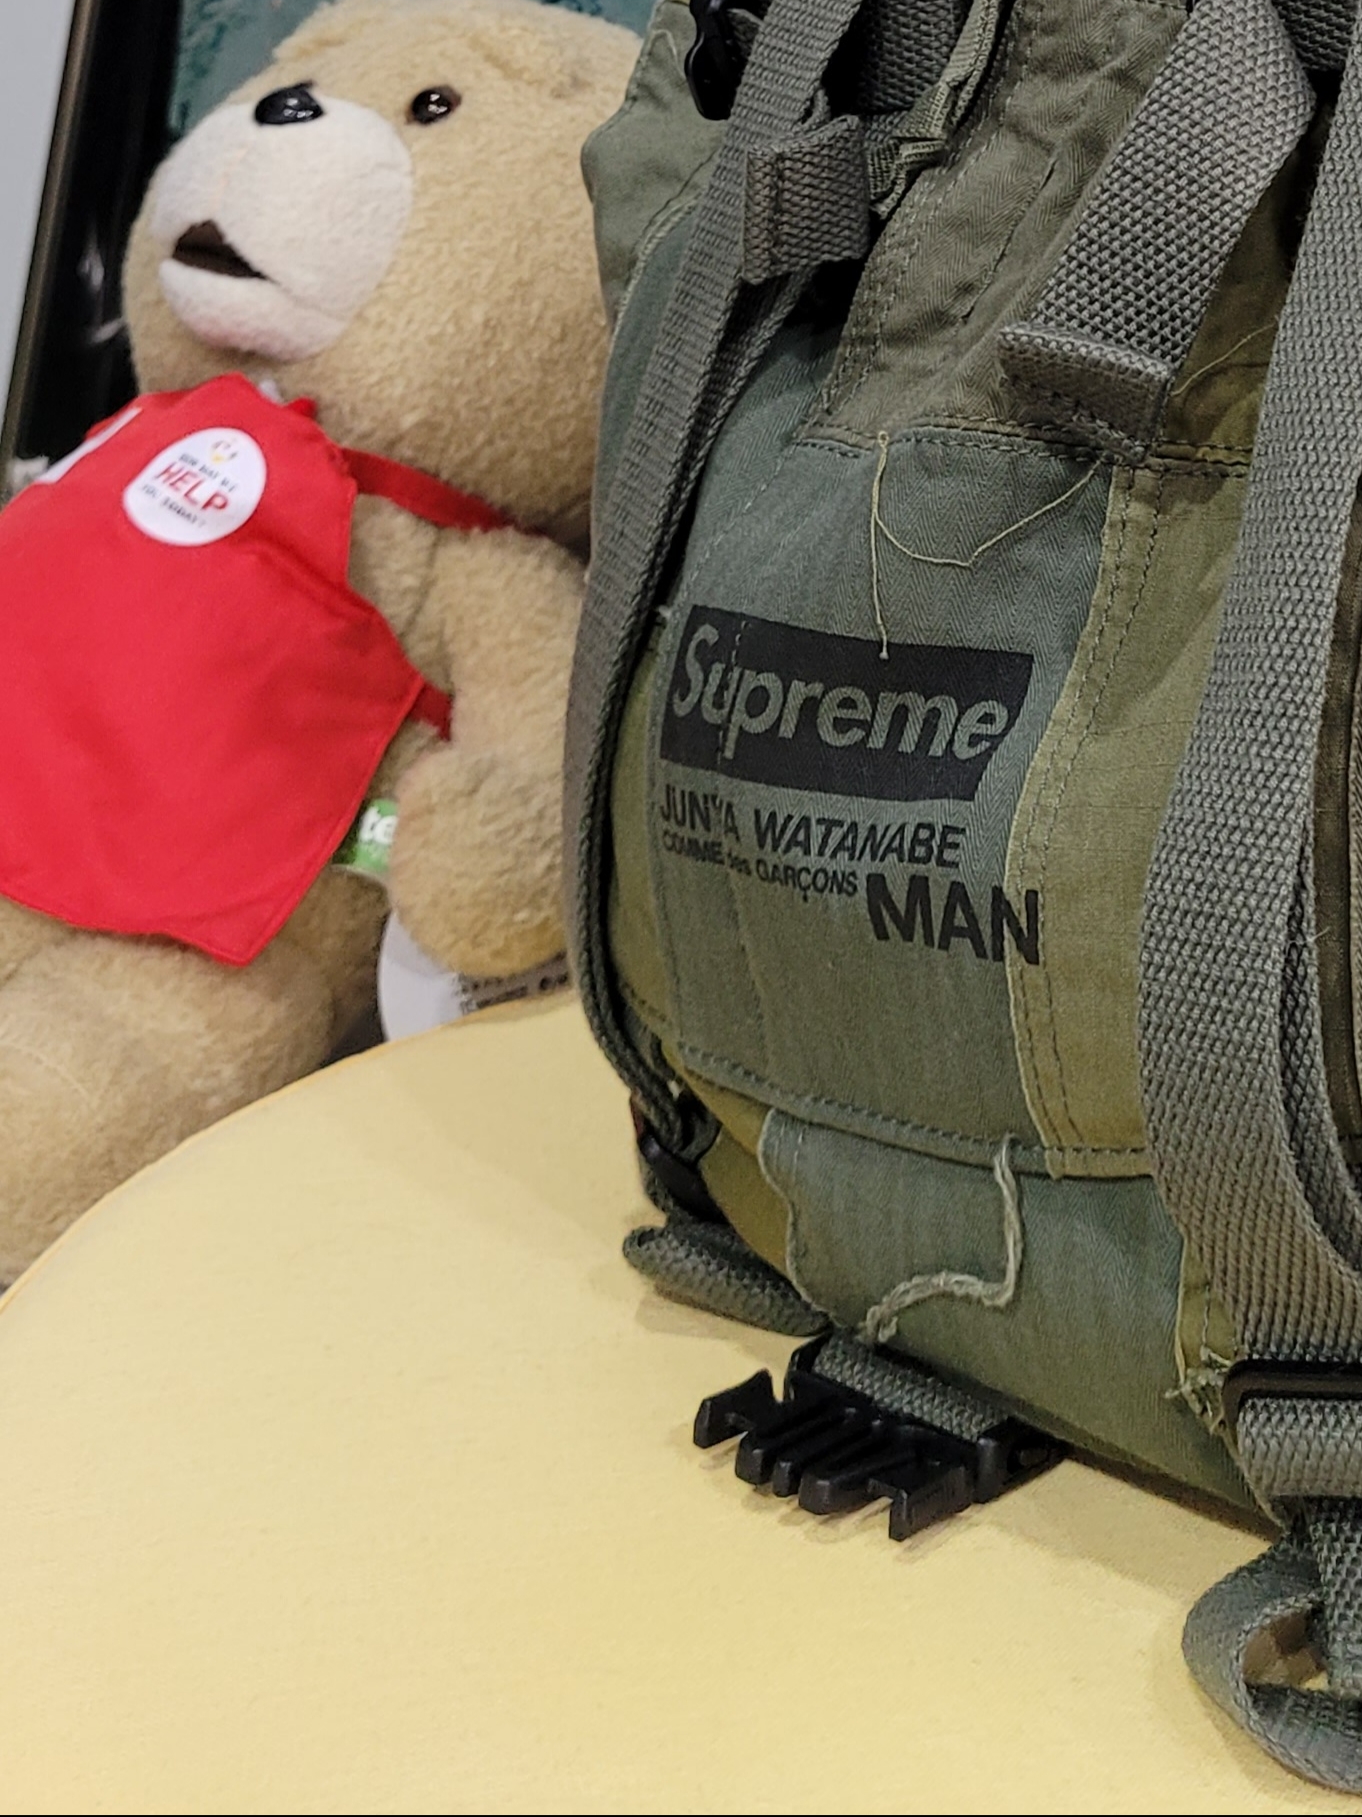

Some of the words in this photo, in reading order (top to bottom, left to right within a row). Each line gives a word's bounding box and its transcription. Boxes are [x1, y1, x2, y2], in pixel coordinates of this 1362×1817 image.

[154, 461, 229, 512] HELP
[673, 623, 1009, 761] Supreme
[754, 809, 966, 868] WATANABE
[757, 861, 858, 903] GARÇONS
[866, 873, 1041, 966] MAN
